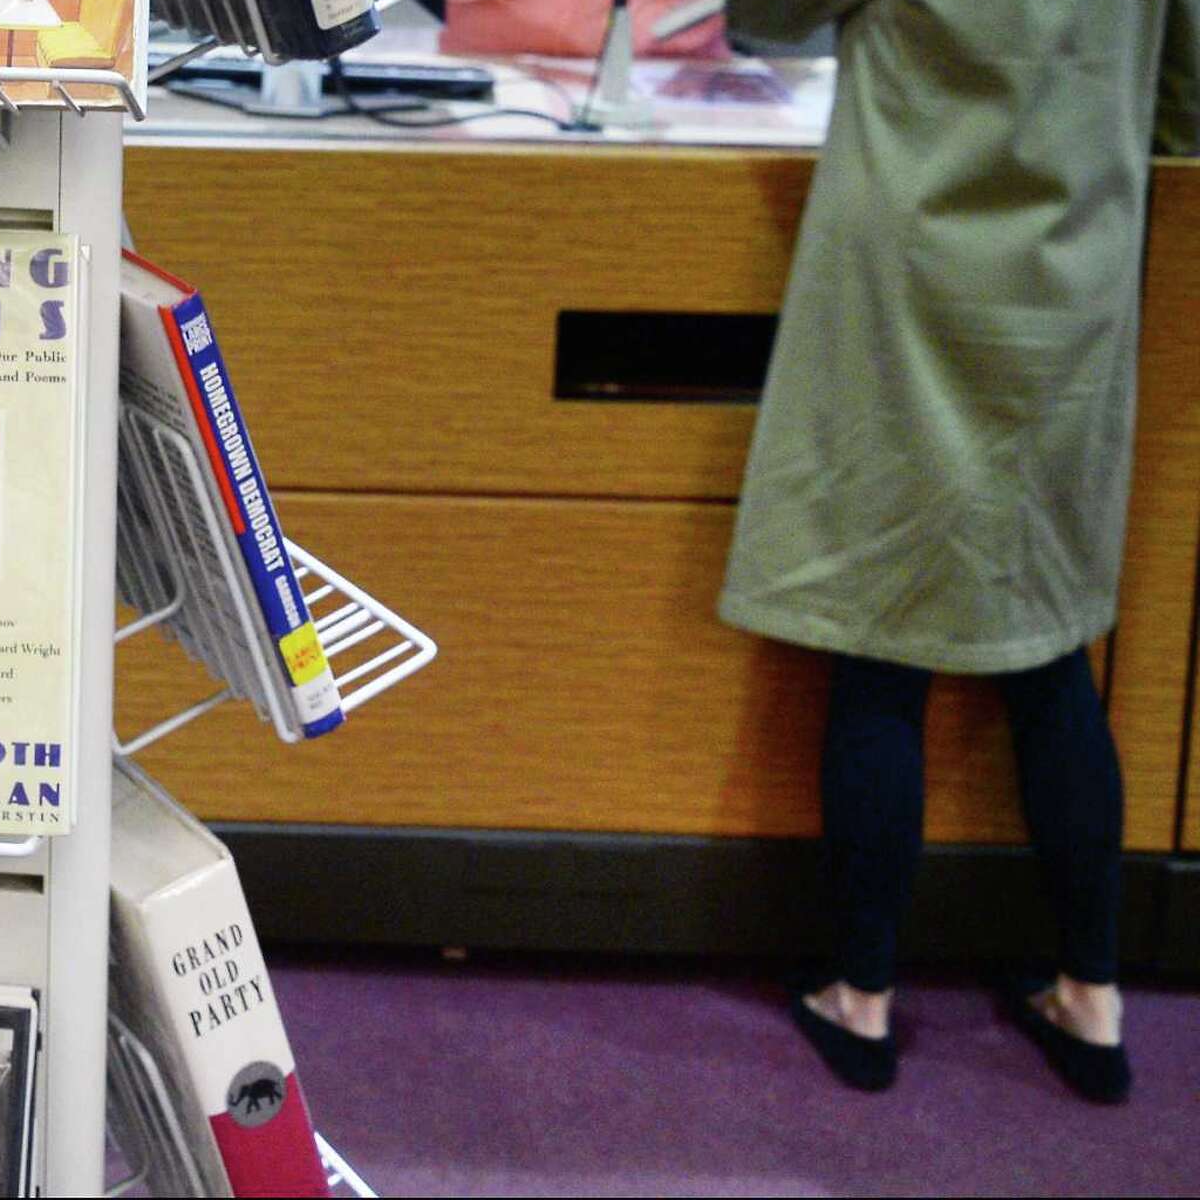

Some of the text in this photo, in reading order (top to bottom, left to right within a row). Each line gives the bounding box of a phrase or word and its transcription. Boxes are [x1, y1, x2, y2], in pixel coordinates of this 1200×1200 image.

[25, 351, 67, 364] Public
[25, 371, 67, 384] Poems
[199, 361, 285, 573] HOMEGROWN DEMOCRAT
[21, 643, 61, 658] Wright
[172, 923, 243, 977] GRAND
[199, 958, 240, 995] OLD
[188, 974, 264, 1038] PARTY
